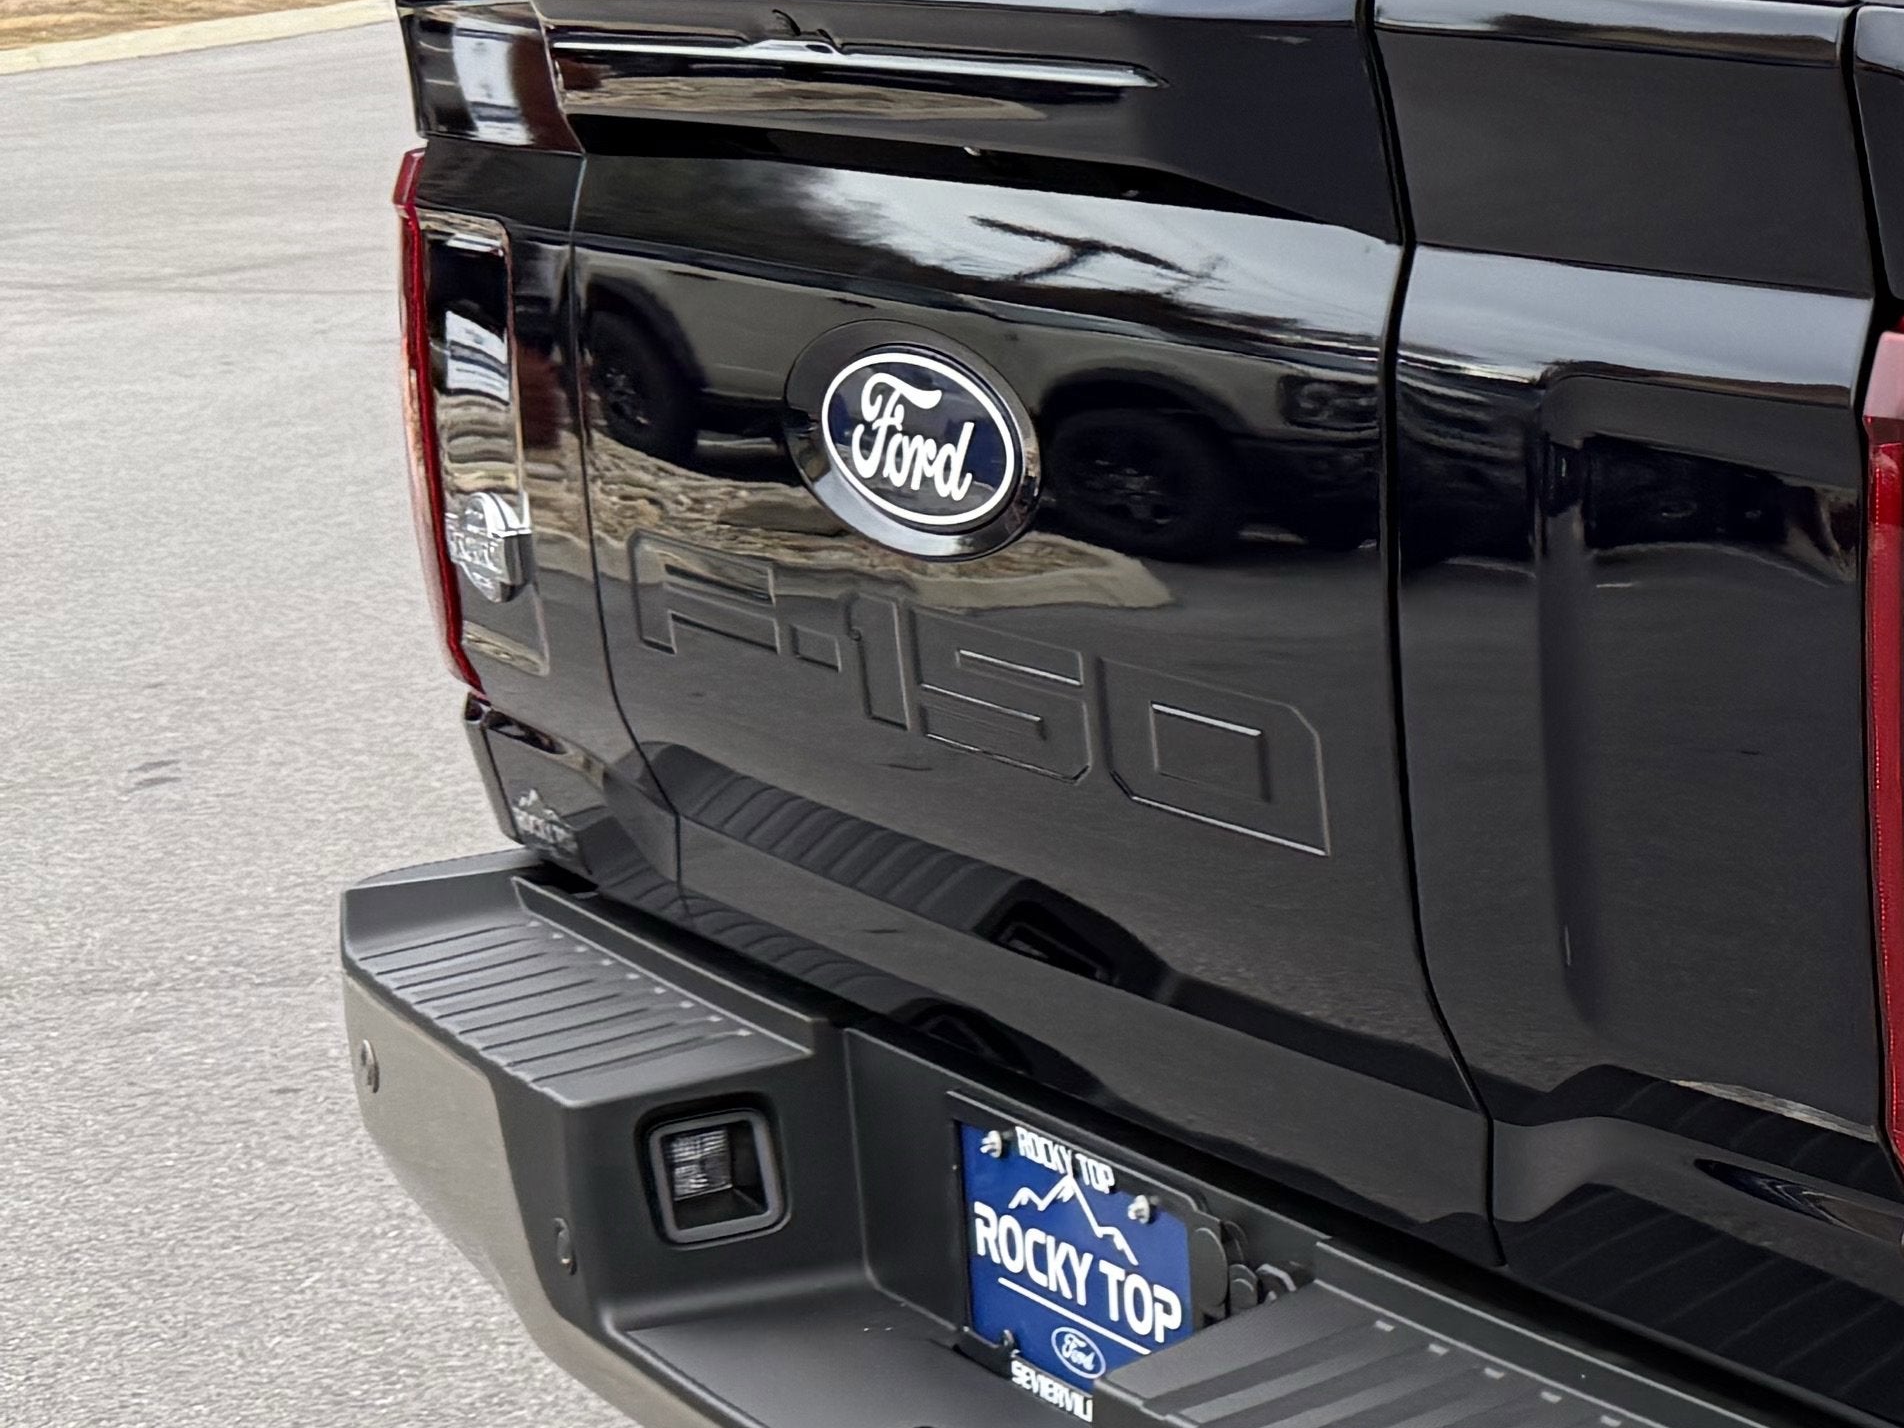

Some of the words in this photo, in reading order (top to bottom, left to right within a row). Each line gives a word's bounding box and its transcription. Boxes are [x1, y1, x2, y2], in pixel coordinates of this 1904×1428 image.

[852, 372, 975, 501] Ford
[626, 527, 1332, 858] F-150
[1015, 1126, 1073, 1175] ROCKY
[1075, 1153, 1116, 1195] TOP
[973, 1201, 1093, 1306] ROCKY
[1098, 1260, 1182, 1344] TOP
